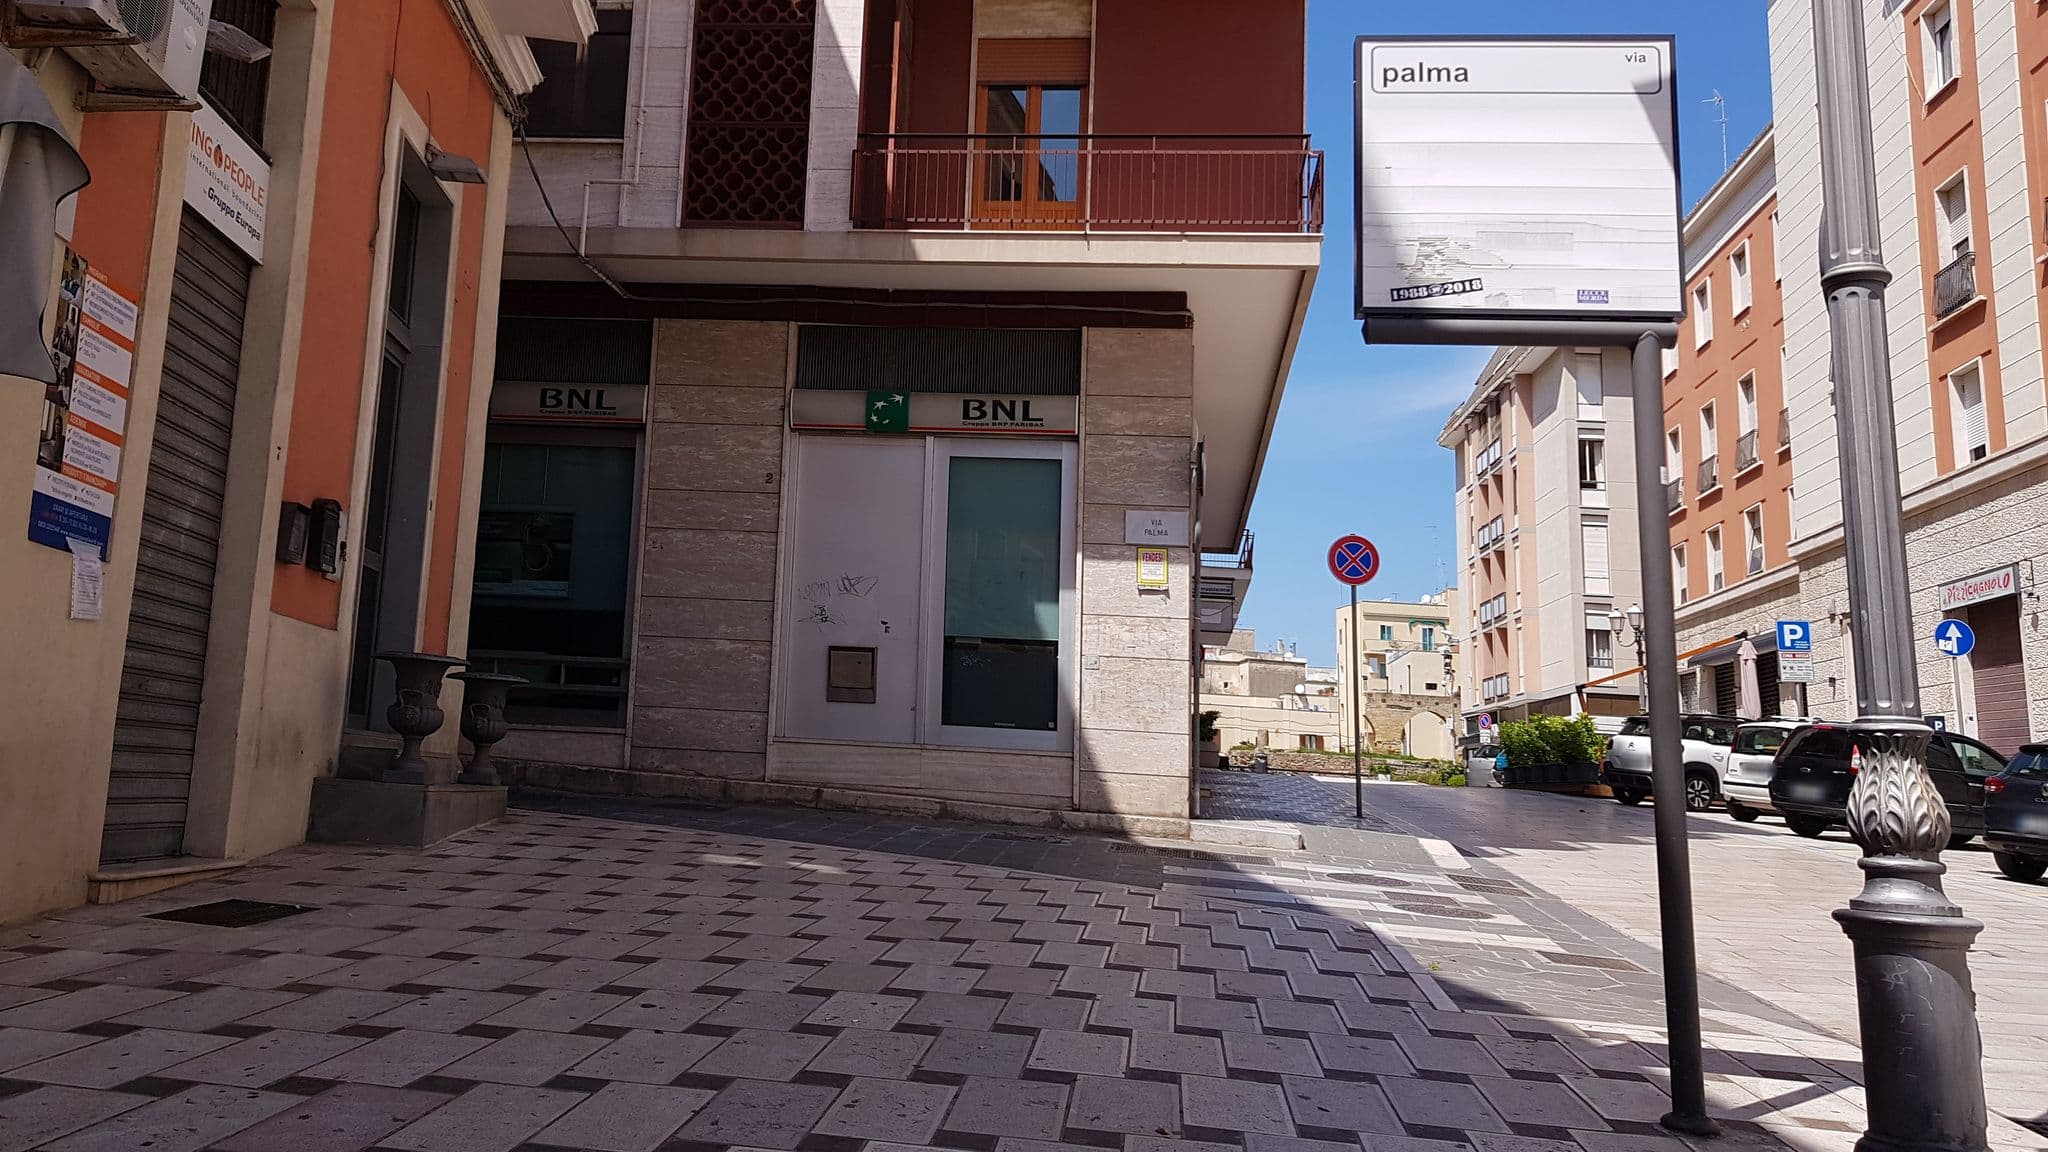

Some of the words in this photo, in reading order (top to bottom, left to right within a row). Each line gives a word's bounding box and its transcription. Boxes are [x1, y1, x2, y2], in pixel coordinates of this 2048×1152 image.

[1625, 52, 1646, 63] via
[1382, 62, 1469, 87] palma
[190, 122, 213, 156] ING
[223, 153, 264, 208] PEOPLE
[207, 186, 236, 219] Gruppo
[235, 211, 262, 242] Europa
[1391, 286, 1428, 300] 1988
[1444, 279, 1482, 294] 2018
[539, 387, 617, 410] BNL
[962, 398, 1044, 421] BNL
[962, 420, 990, 428] Gruppo
[765, 472, 774, 484] 2
[1144, 528, 1169, 537] PALMA
[1783, 624, 1803, 647] P
[1934, 720, 1944, 731] P
